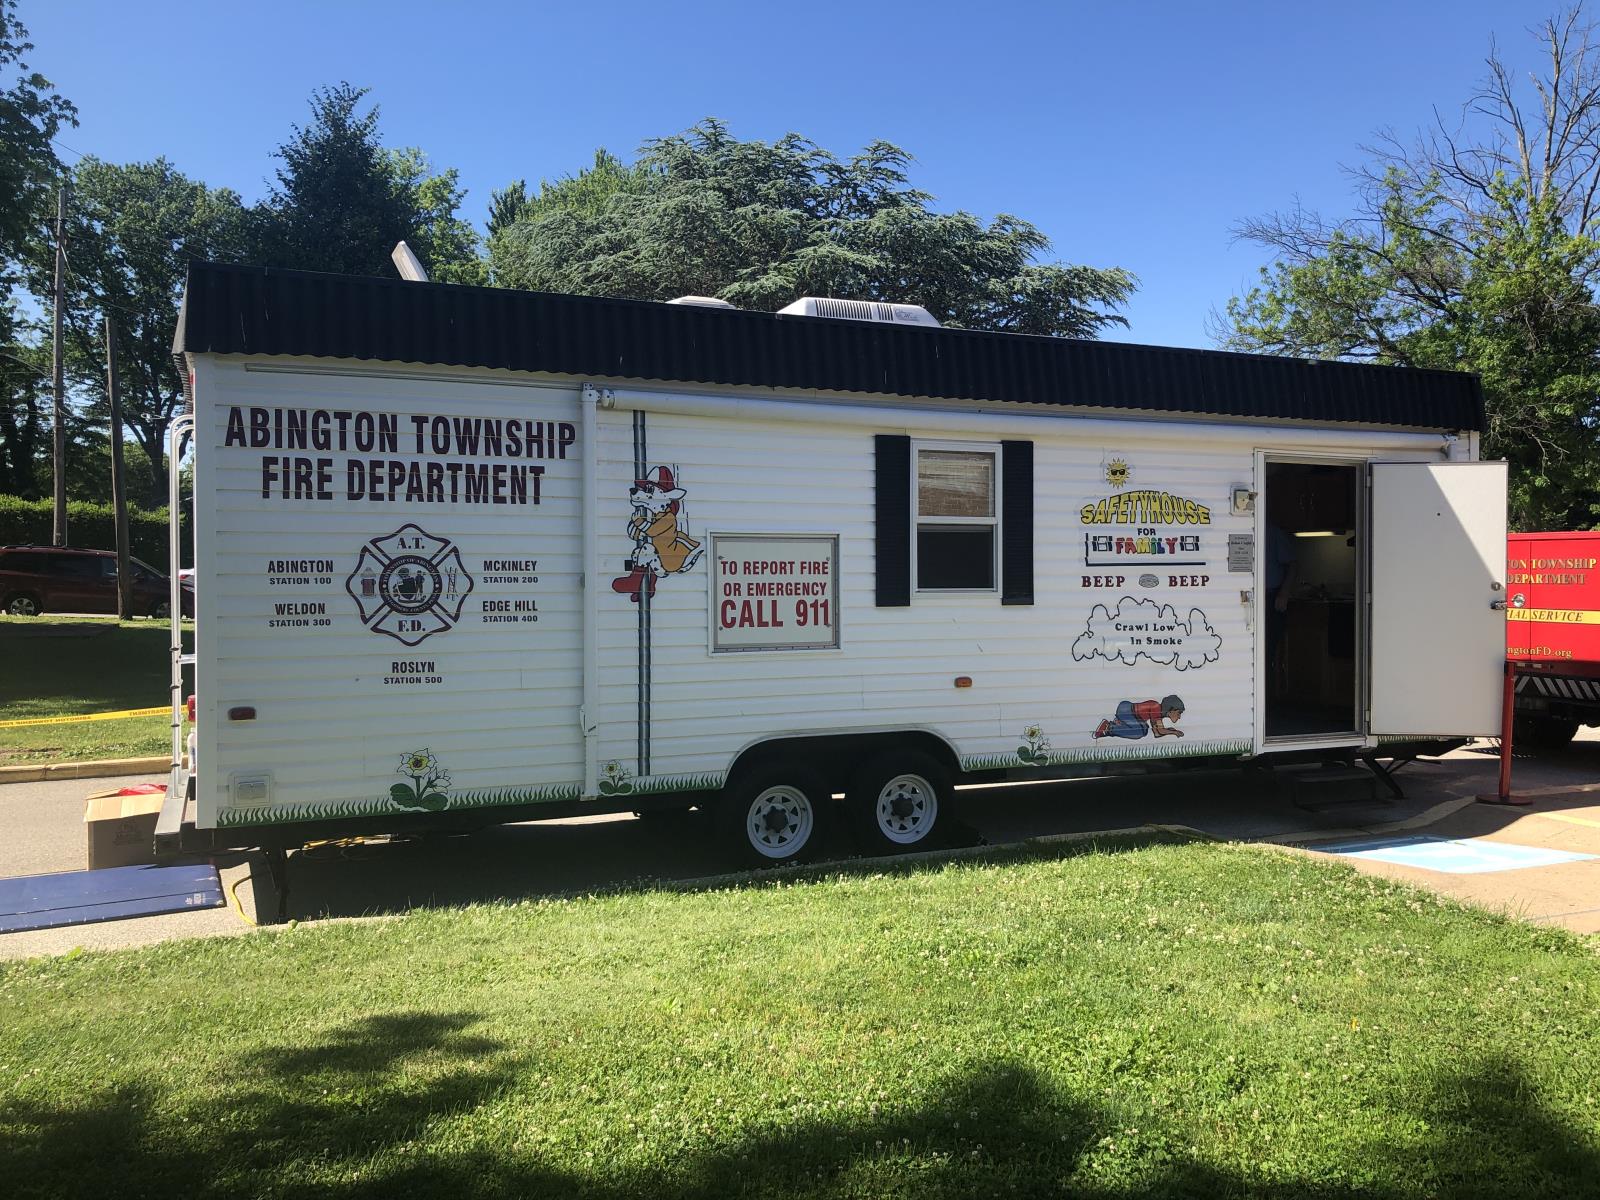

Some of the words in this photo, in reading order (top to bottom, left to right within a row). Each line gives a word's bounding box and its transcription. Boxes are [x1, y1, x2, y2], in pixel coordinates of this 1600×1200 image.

[225, 407, 397, 452] ABINGTON
[411, 416, 575, 459] TOWNSHIP
[263, 456, 332, 500] FIRE
[347, 457, 545, 504] DEPARTMENT
[1081, 490, 1210, 524] SAFETYHOUSE
[1138, 528, 1156, 536] FOR
[397, 537, 425, 550] A.T.
[1115, 537, 1178, 554] FAMILY
[268, 560, 333, 573] ABINGTON
[484, 561, 536, 572] MCKINLEY
[721, 561, 737, 575] TO
[744, 561, 795, 574] REPORT
[801, 561, 828, 575] FIRE
[1508, 560, 1527, 570] ON
[1531, 559, 1597, 570] TOWNSHIP
[1082, 576, 1125, 587] BEEP
[1169, 576, 1209, 586] BEEP
[1507, 573, 1585, 584] DEPARTMENT
[724, 583, 741, 596] OR
[748, 582, 826, 596] EMERGENCY
[275, 603, 325, 615] WELDON
[483, 601, 510, 611] EDGE
[515, 601, 537, 611] HILL
[721, 600, 783, 628] CALL
[796, 600, 829, 626] 911
[1508, 610, 1527, 620] IAL
[1531, 611, 1583, 622] SERVICE
[269, 619, 308, 628] STATION
[313, 619, 330, 627] 300
[398, 620, 425, 632] F.D.
[1115, 623, 1148, 632] Crawl
[1154, 623, 1175, 632] Low
[1131, 637, 1141, 645] In
[1147, 637, 1182, 645] Smoke
[392, 662, 434, 673] ROSLYN
[384, 677, 421, 685] STATION
